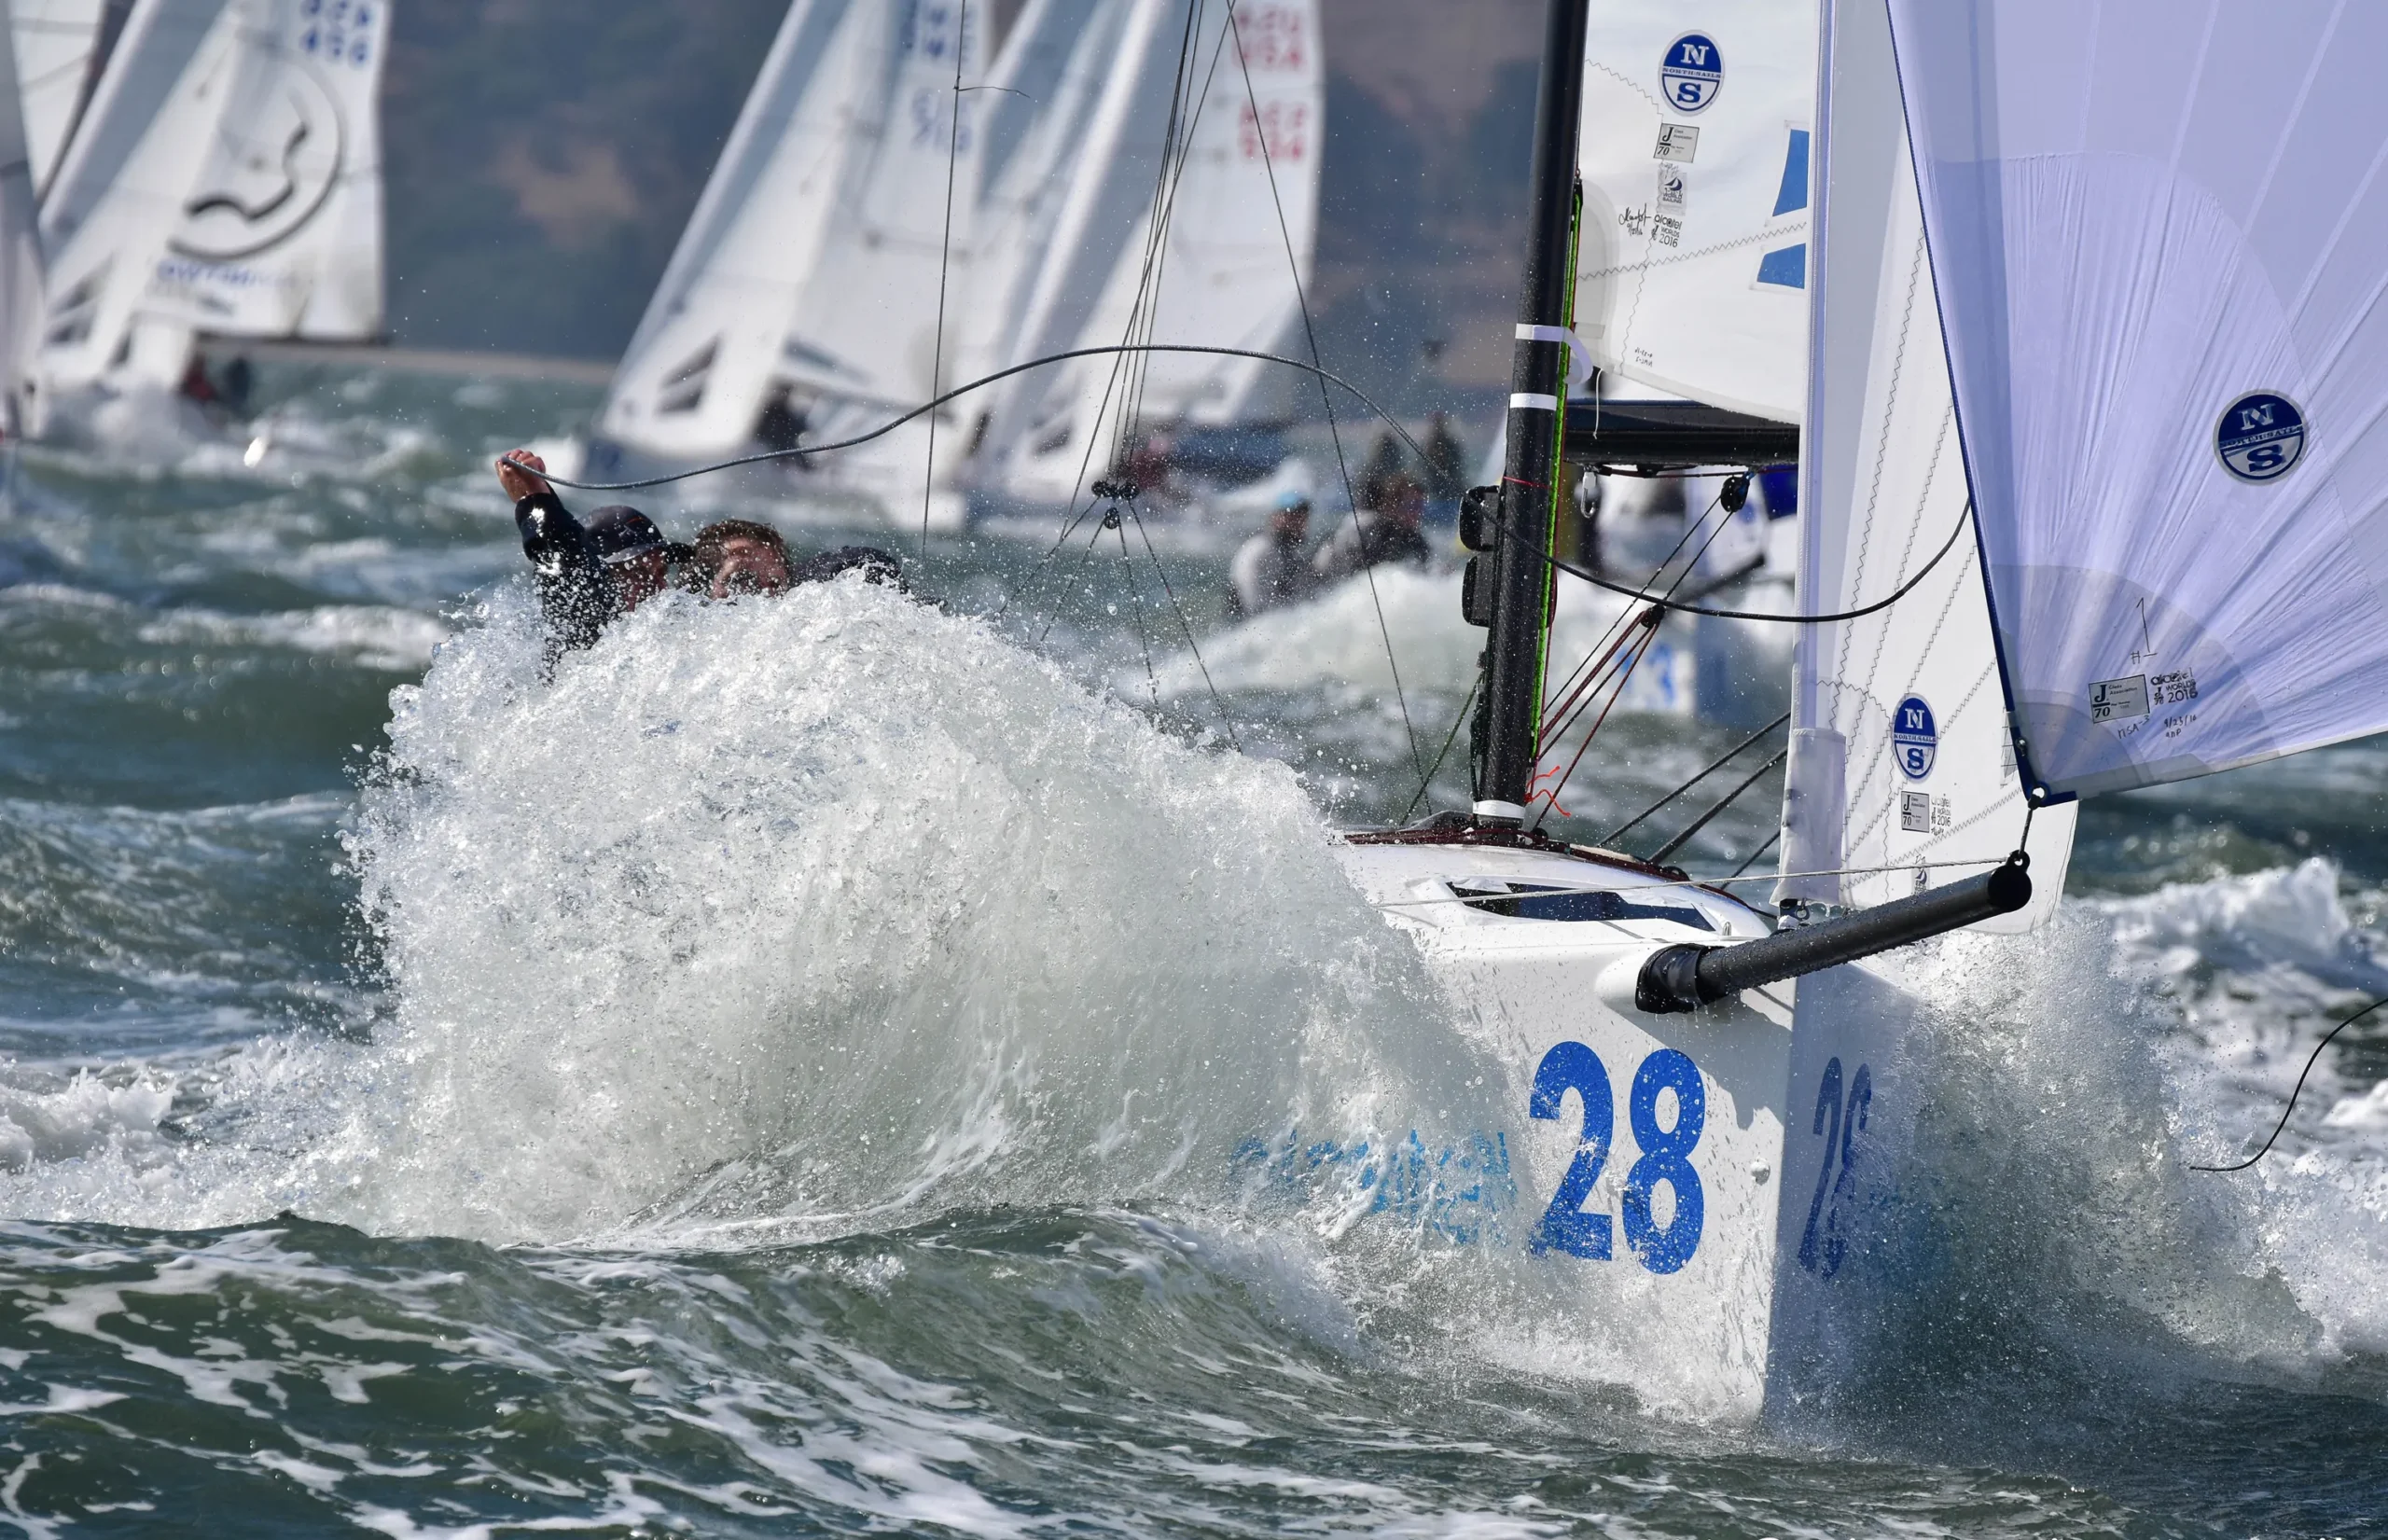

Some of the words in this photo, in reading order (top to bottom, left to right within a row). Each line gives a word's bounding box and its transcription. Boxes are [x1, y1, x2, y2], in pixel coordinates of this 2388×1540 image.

[1681, 43, 1709, 65] N
[1662, 67, 1693, 76] NORTH
[1677, 82, 1701, 103] S
[1661, 127, 1673, 142] J
[1657, 146, 1670, 156] 70
[1659, 233, 1678, 248] 2016
[2238, 403, 2275, 431] N
[2247, 444, 2285, 472] S
[2094, 685, 2107, 702] J
[2168, 688, 2198, 703] 2016
[1905, 709, 1924, 729] N
[2094, 706, 2110, 718] 70
[1907, 748, 1924, 770] S
[1903, 795, 1911, 811] J
[1903, 816, 1911, 825] 70
[1529, 1040, 1705, 1275] 28
